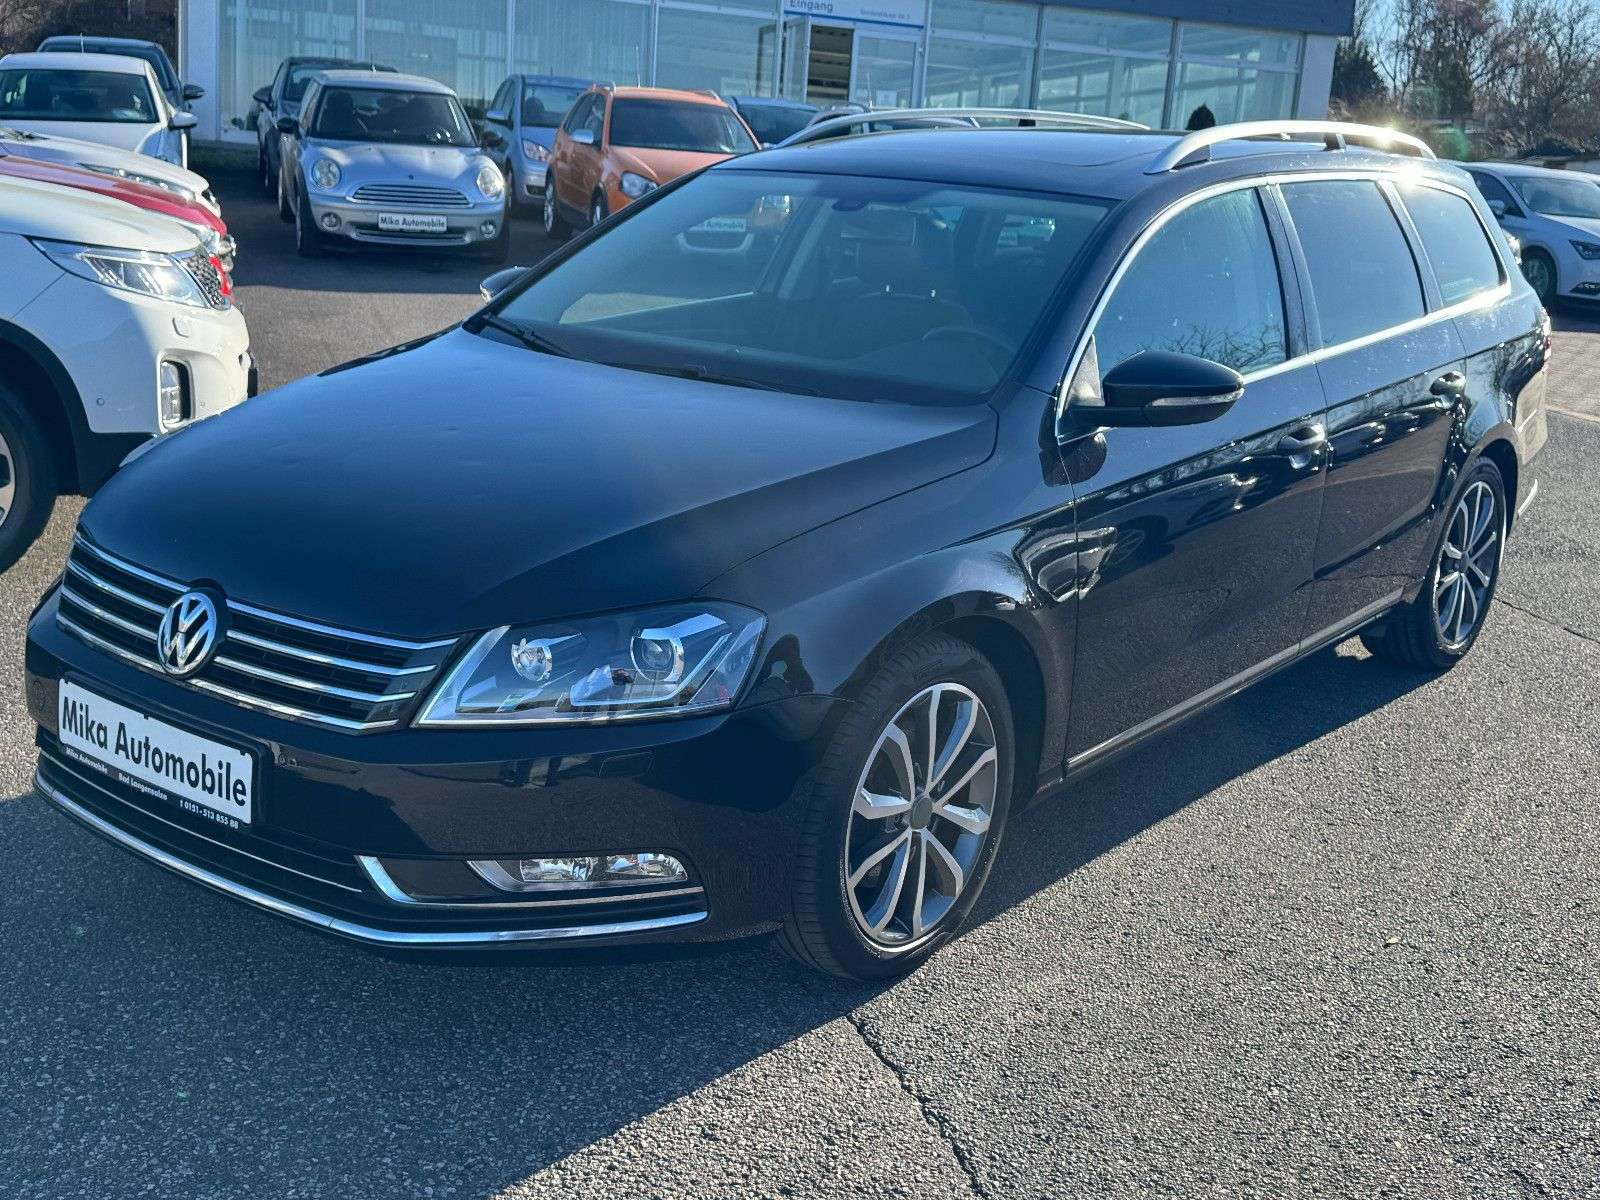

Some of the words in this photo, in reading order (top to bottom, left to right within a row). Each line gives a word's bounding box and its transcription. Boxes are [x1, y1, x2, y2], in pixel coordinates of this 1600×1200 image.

[402, 217, 445, 227] Automobile
[62, 696, 108, 750] Mika
[115, 721, 247, 807] Automobile
[118, 772, 130, 784] Bad
